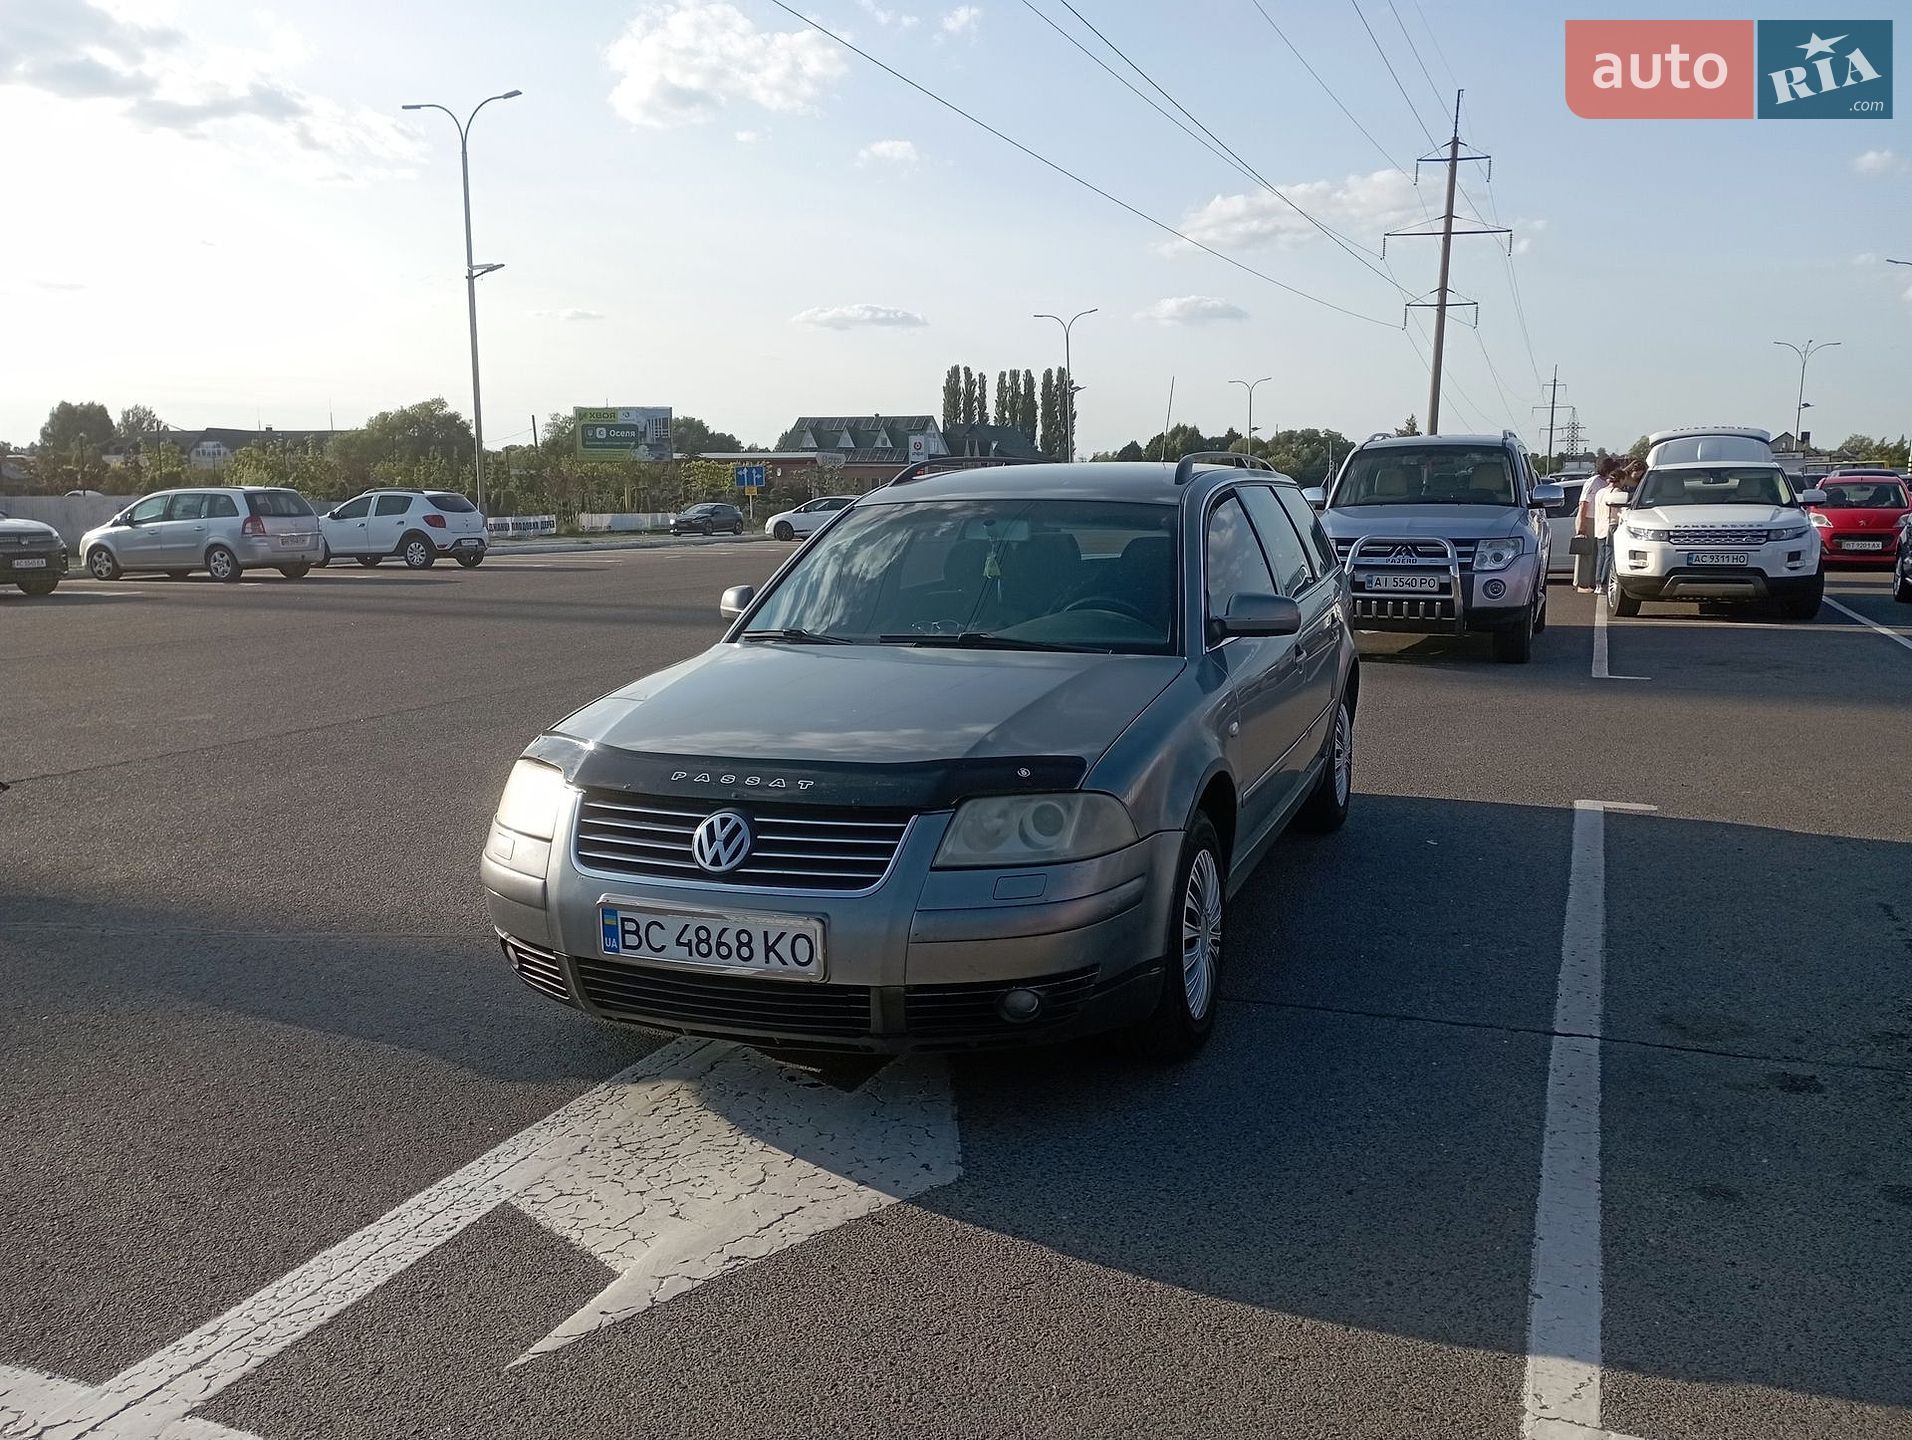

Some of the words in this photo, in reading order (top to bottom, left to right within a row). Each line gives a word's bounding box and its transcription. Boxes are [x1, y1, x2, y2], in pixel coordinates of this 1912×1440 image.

[1694, 555, 1707, 563] AC
[1709, 555, 1729, 563] 9311
[1732, 555, 1746, 563] HO
[1374, 577, 1388, 588] AI
[1392, 577, 1418, 588] 5540
[1419, 578, 1436, 588] PO
[670, 771, 814, 790] PASSAT
[604, 936, 618, 950] UA
[620, 916, 667, 953] BC
[675, 923, 754, 962] 4868
[763, 930, 815, 967] KO
